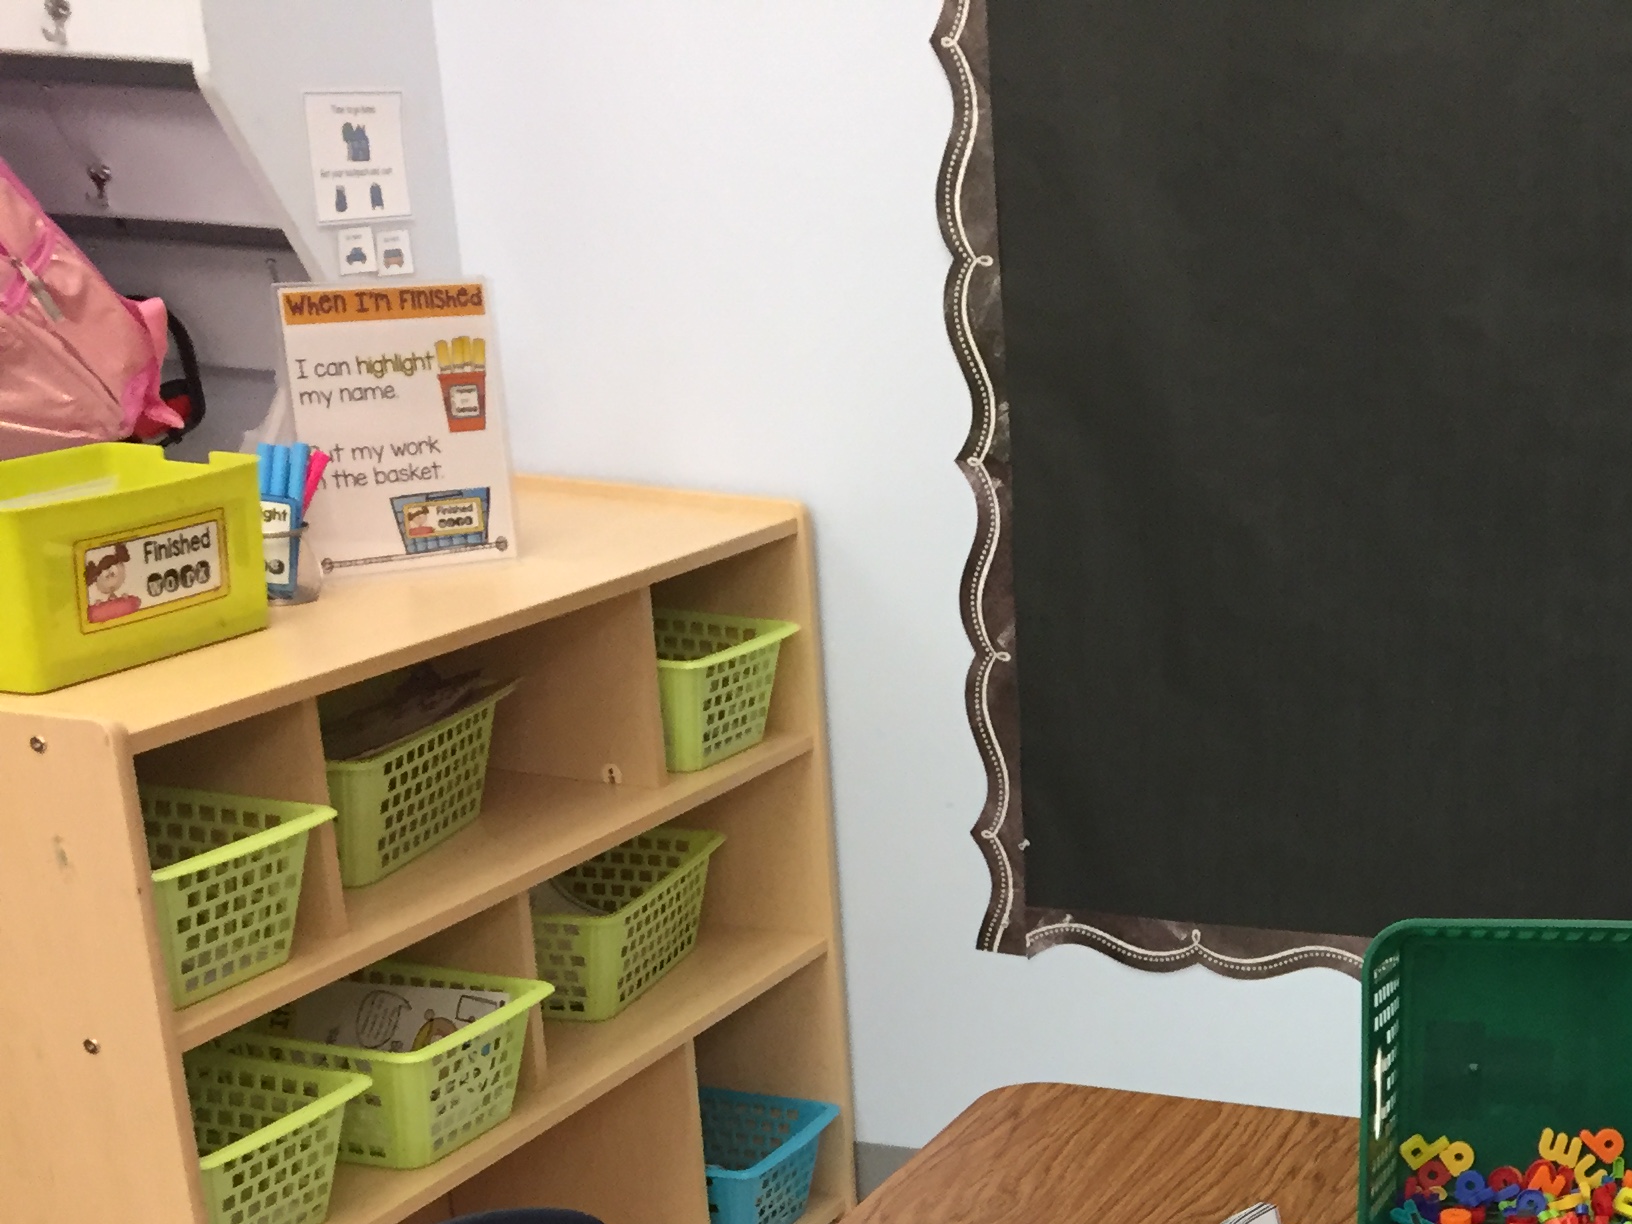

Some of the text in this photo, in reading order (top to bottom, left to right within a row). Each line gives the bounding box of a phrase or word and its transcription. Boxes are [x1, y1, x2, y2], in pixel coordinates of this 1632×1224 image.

[294, 351, 435, 380] I can highlight
[299, 388, 332, 409] my
[351, 444, 385, 463] my
[390, 435, 442, 457] work
[331, 469, 368, 488] the
[143, 526, 211, 565] Finished
